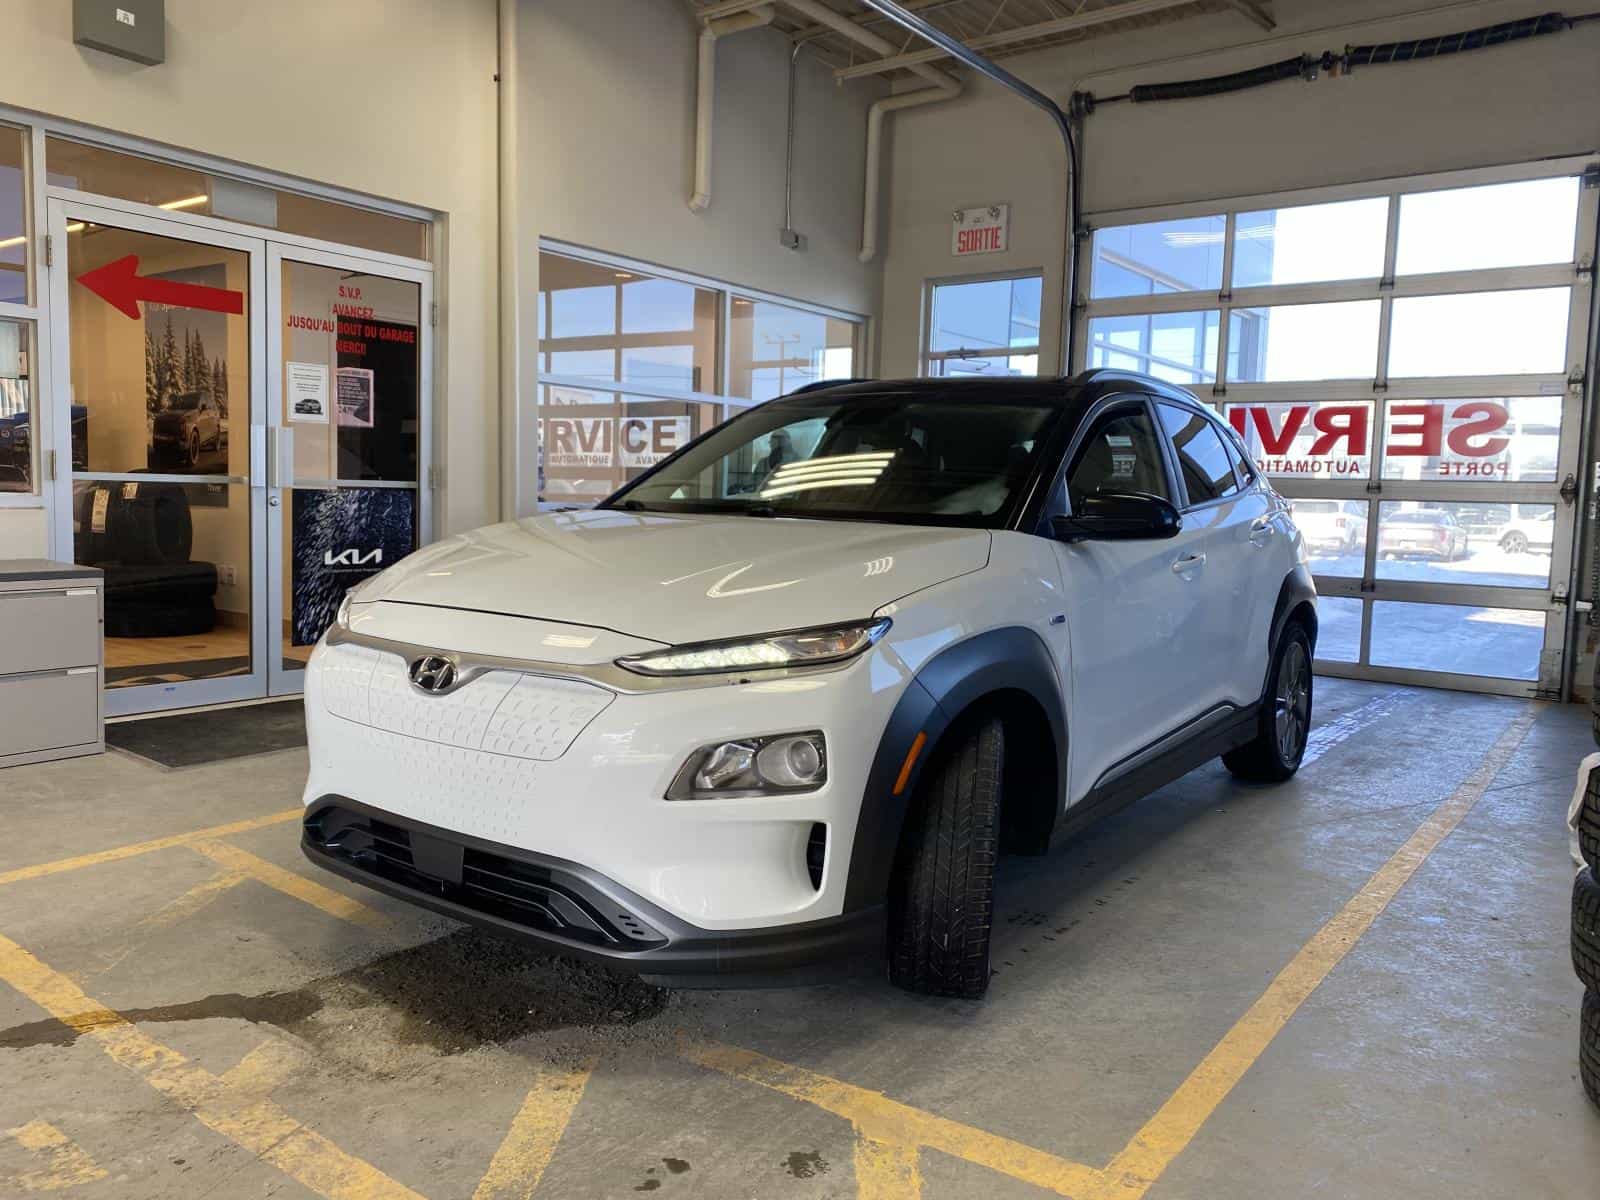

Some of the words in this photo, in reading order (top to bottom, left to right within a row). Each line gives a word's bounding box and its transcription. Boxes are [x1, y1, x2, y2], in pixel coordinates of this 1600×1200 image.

[958, 227, 1001, 252] SORTIE
[338, 286, 362, 300] S.V.P.
[332, 303, 375, 319] AVANCEZ
[287, 315, 335, 333] JUSQU'AU
[337, 321, 362, 337] BOUT
[364, 326, 378, 339] DU
[380, 327, 416, 343] GARAGE
[324, 548, 383, 565] KIA
